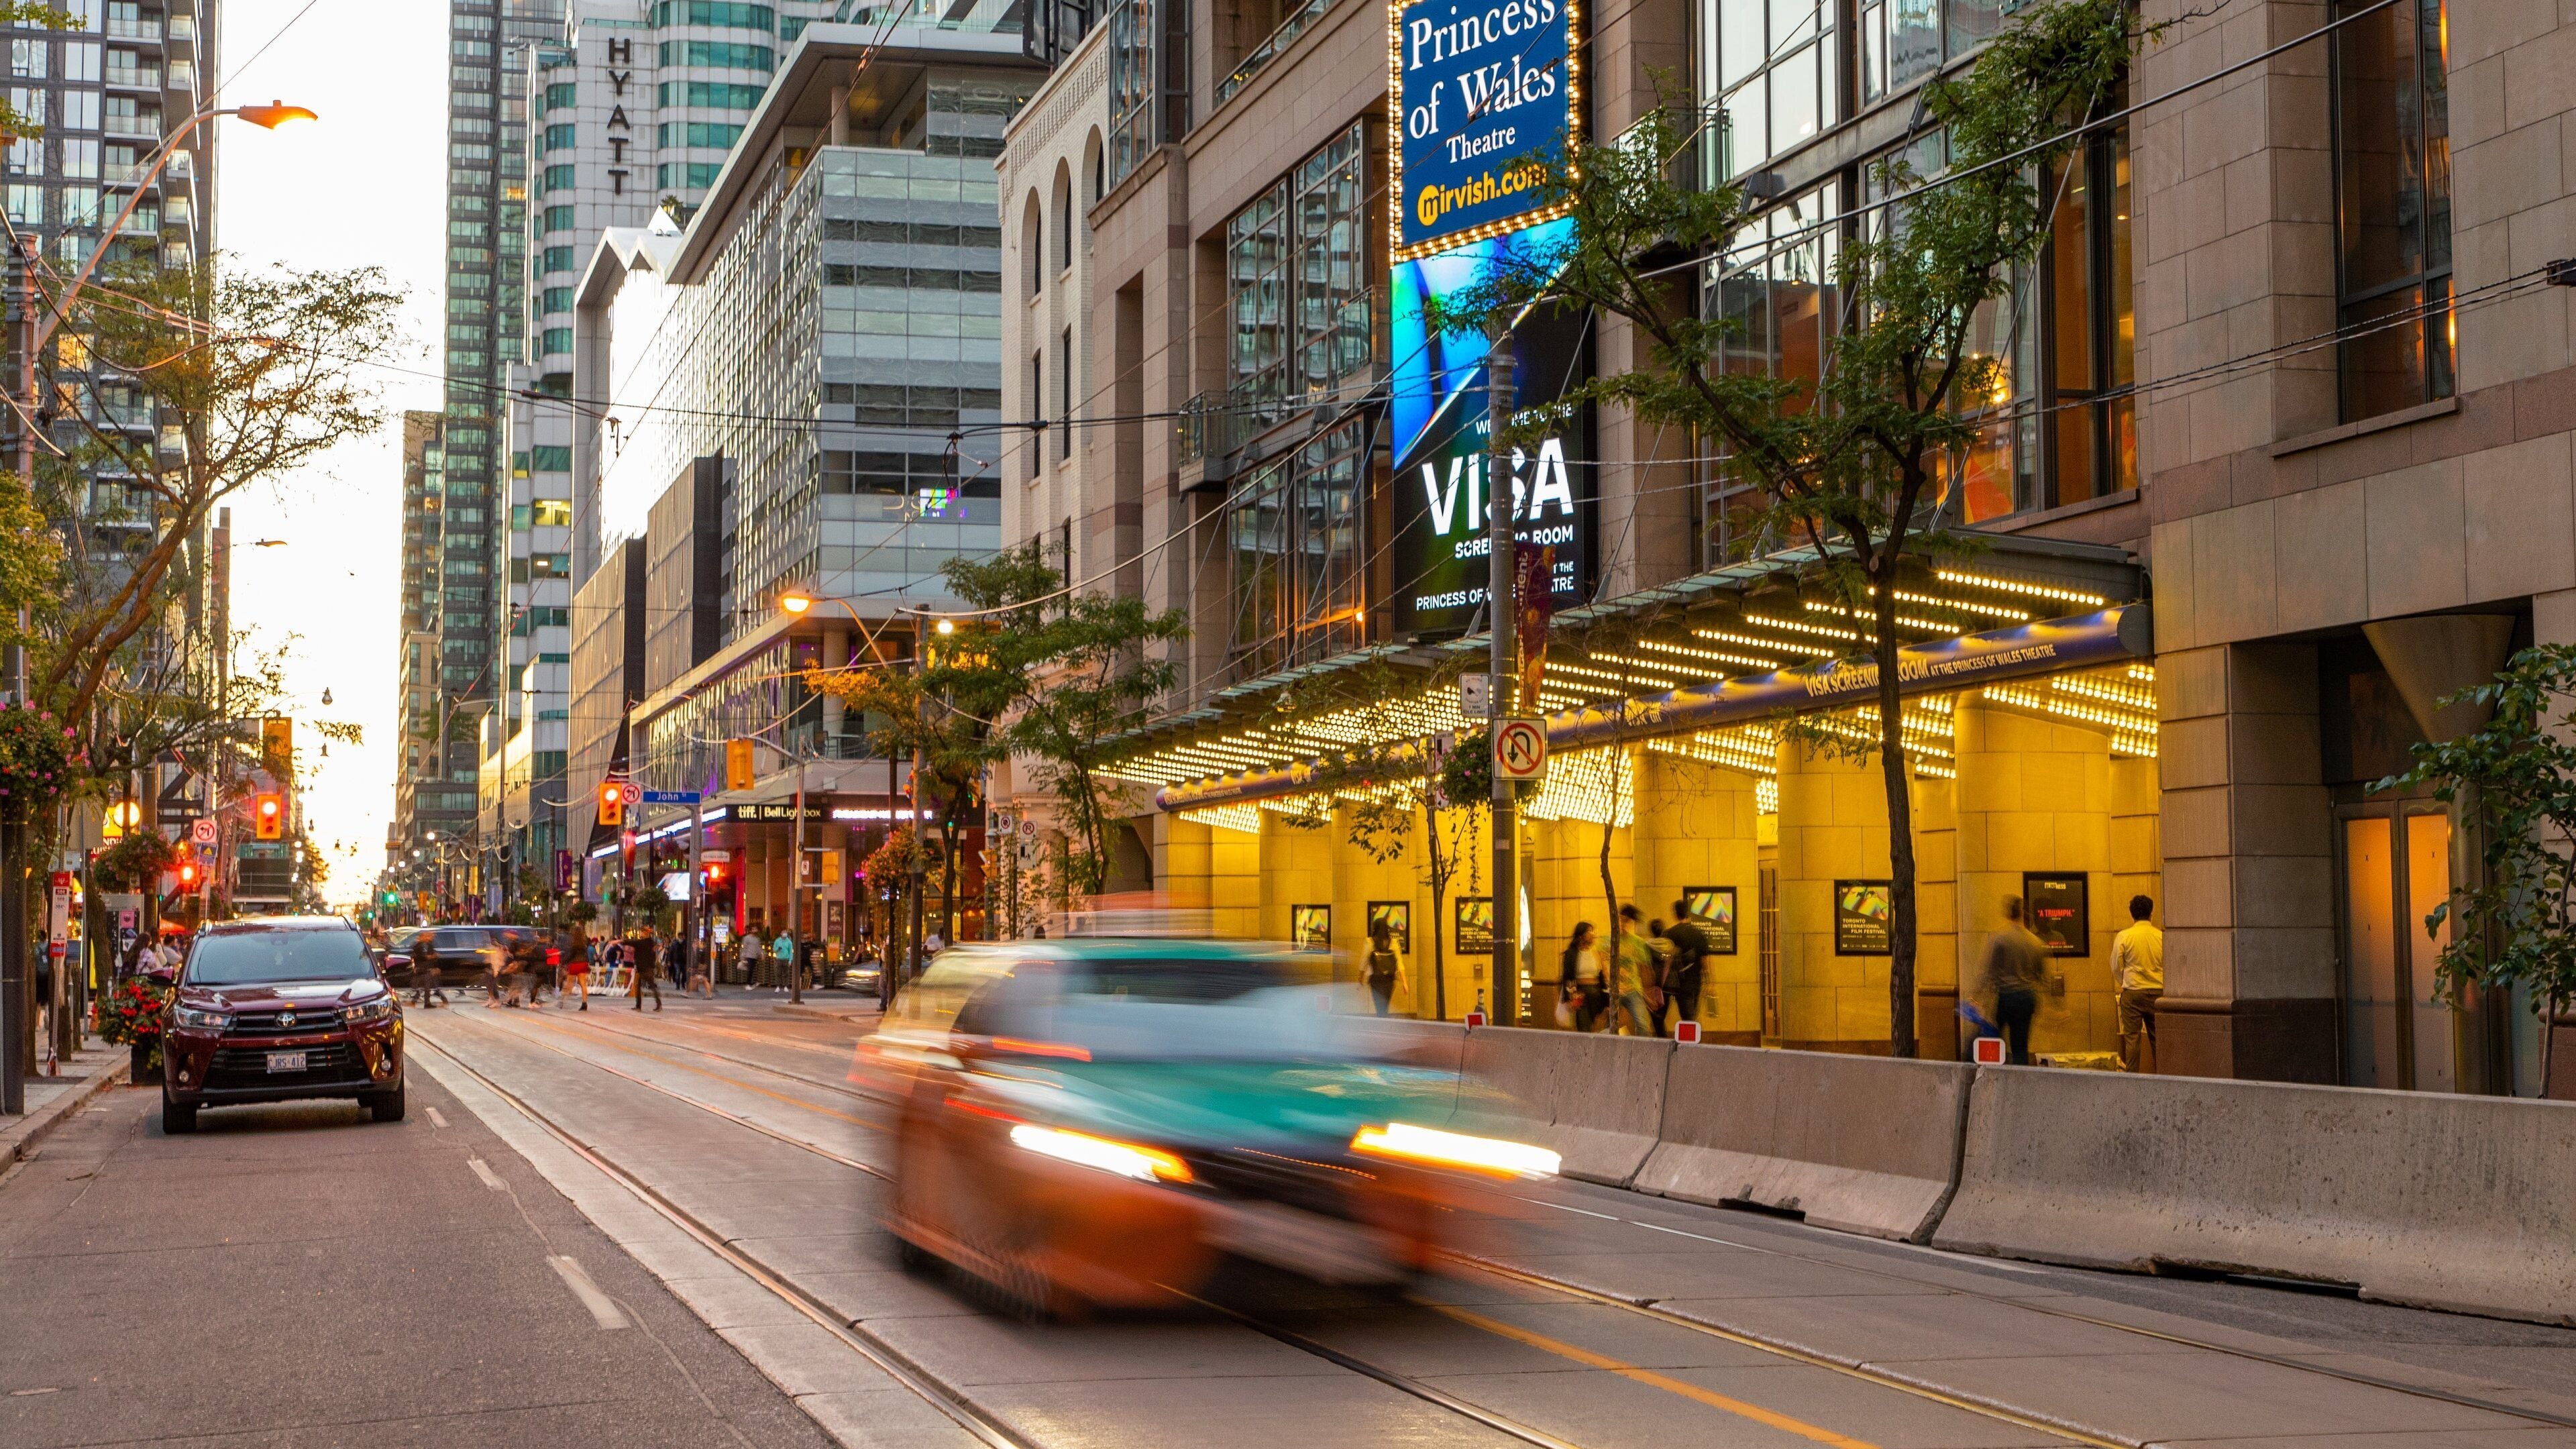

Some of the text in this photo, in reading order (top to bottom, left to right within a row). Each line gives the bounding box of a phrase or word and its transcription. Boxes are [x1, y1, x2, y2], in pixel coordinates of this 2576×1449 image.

[1409, 0, 1556, 71] Princess
[1409, 54, 1556, 140] of Wales
[606, 38, 631, 195] HYATT
[1446, 126, 1516, 164] Theatre
[1532, 524, 1574, 545] ROOM
[1559, 561, 1574, 573] THE
[1416, 591, 1466, 611] PRINCESS
[1468, 588, 1484, 604] OF
[1805, 674, 1832, 697] VISA
[1830, 666, 1879, 694] SCREENI
[1930, 663, 1940, 677] AT
[1939, 661, 1954, 675] THE
[1951, 656, 1987, 674] PRINCESS
[1986, 655, 1996, 667] OF
[1994, 650, 2023, 666] WALES
[2020, 643, 2057, 661] THEATRE
[657, 792, 679, 801] John
[738, 805, 757, 818] tiff.
[781, 806, 821, 820] Lighbox
[291, 1057, 305, 1067] 412
